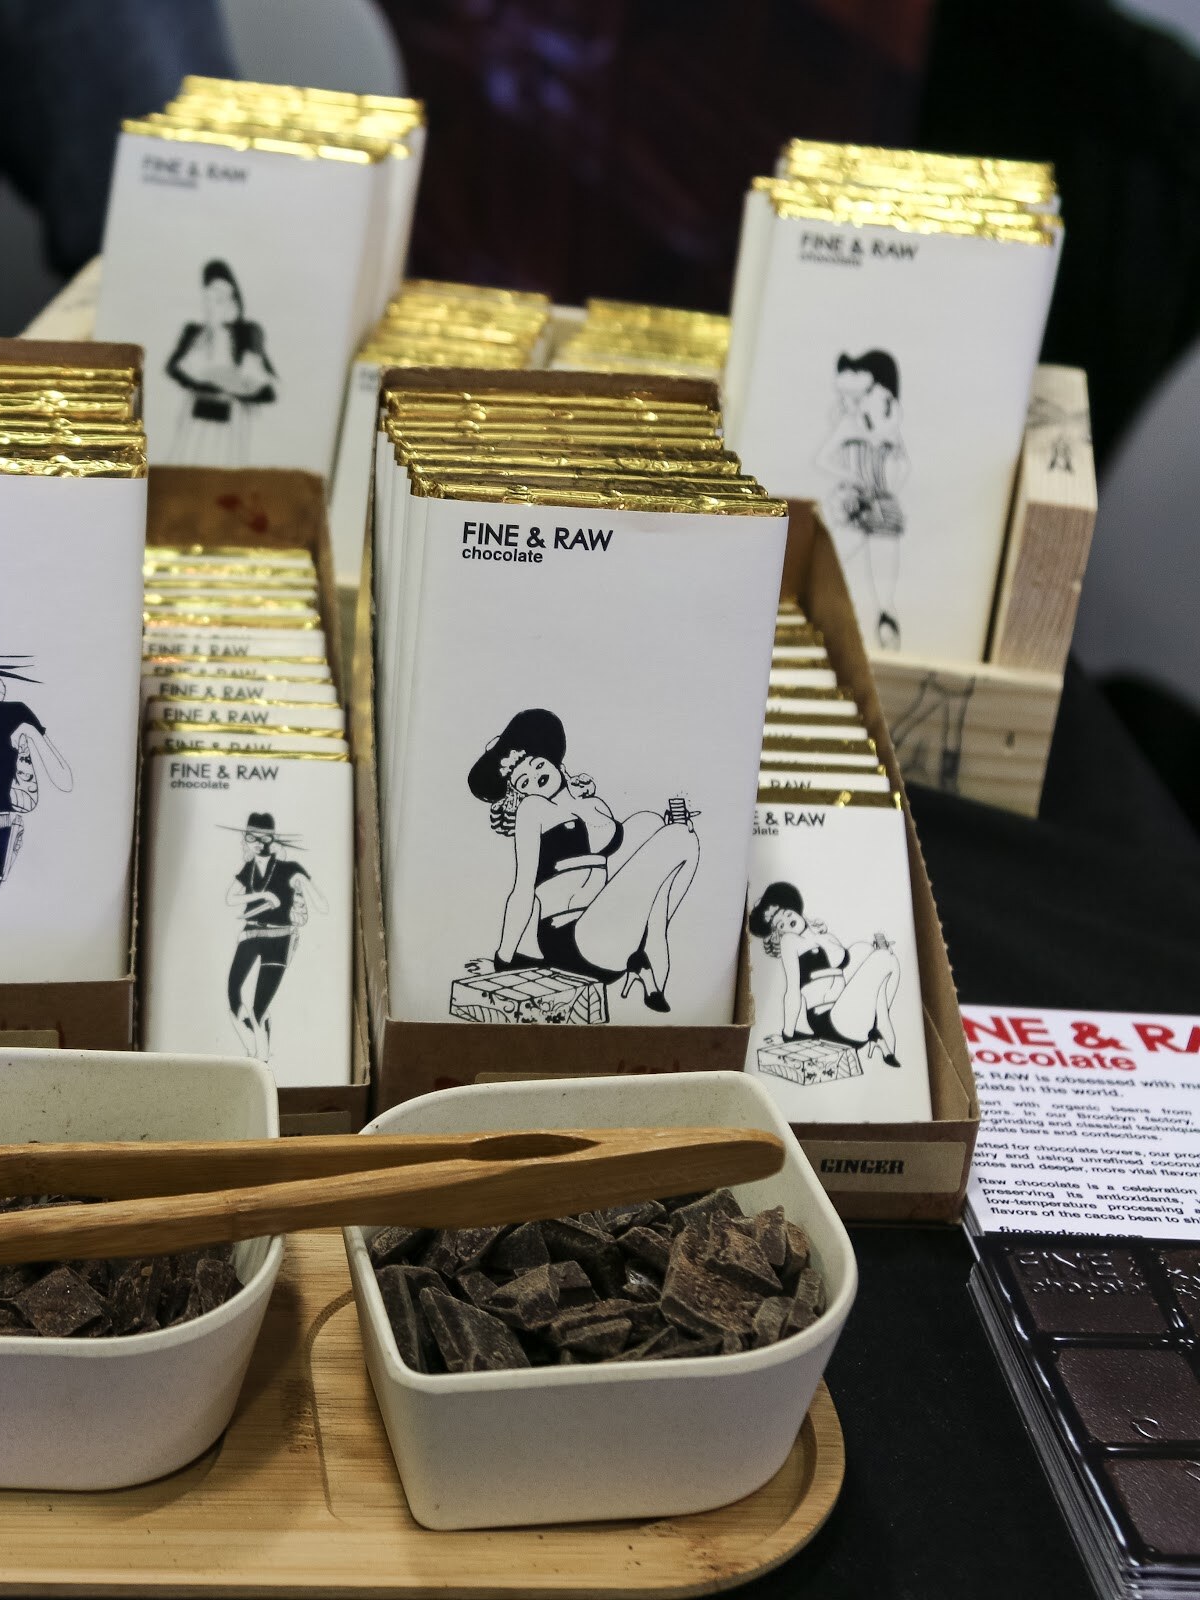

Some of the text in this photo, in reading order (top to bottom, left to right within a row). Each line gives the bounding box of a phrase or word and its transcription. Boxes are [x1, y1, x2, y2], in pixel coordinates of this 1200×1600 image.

[462, 521, 613, 551] FINE & RAW
[462, 546, 543, 563] chocolate
[170, 763, 279, 780] FINE & RAW
[170, 780, 230, 790] chocolate
[765, 811, 778, 826] &
[784, 811, 826, 827] RAW
[1071, 1022, 1131, 1051] &
[972, 1050, 1136, 1070] ocolate
[990, 1072, 1029, 1081] RAW
[1056, 1075, 1135, 1087] obsessed
[1140, 1080, 1176, 1089] with
[1020, 1084, 1036, 1093] in
[1040, 1085, 1067, 1095] the
[1071, 1087, 1124, 1097] world.
[1077, 1112, 1136, 1122] Brooklyn
[1161, 1108, 1192, 1116] from
[1076, 1121, 1132, 1130] classical
[1020, 1127, 1049, 1135] bars
[1081, 1131, 1162, 1141] confections.
[1011, 1143, 1030, 1151] for
[1034, 1144, 1098, 1154] chocolate
[1100, 1148, 1146, 1158] lovers,
[820, 1159, 904, 1175] GINGER
[1037, 1154, 1074, 1163] using
[1081, 1157, 1143, 1166] unrefined
[1039, 1163, 1089, 1173] deeper,
[1128, 1168, 1157, 1176] vital
[977, 1177, 1006, 1186] Raw
[1014, 1180, 1081, 1190] chocolate
[1122, 1185, 1198, 1195] celebration
[982, 1188, 1056, 1199] preserving
[1066, 1191, 1084, 1199] its
[1096, 1193, 1184, 1205] antioxidants,
[986, 1197, 1098, 1209] low-temperature
[1107, 1204, 1184, 1215] processing
[990, 1207, 1038, 1216] flavors
[1058, 1210, 1081, 1218] the
[1084, 1213, 1125, 1221] cacao
[1128, 1213, 1162, 1223] bean
